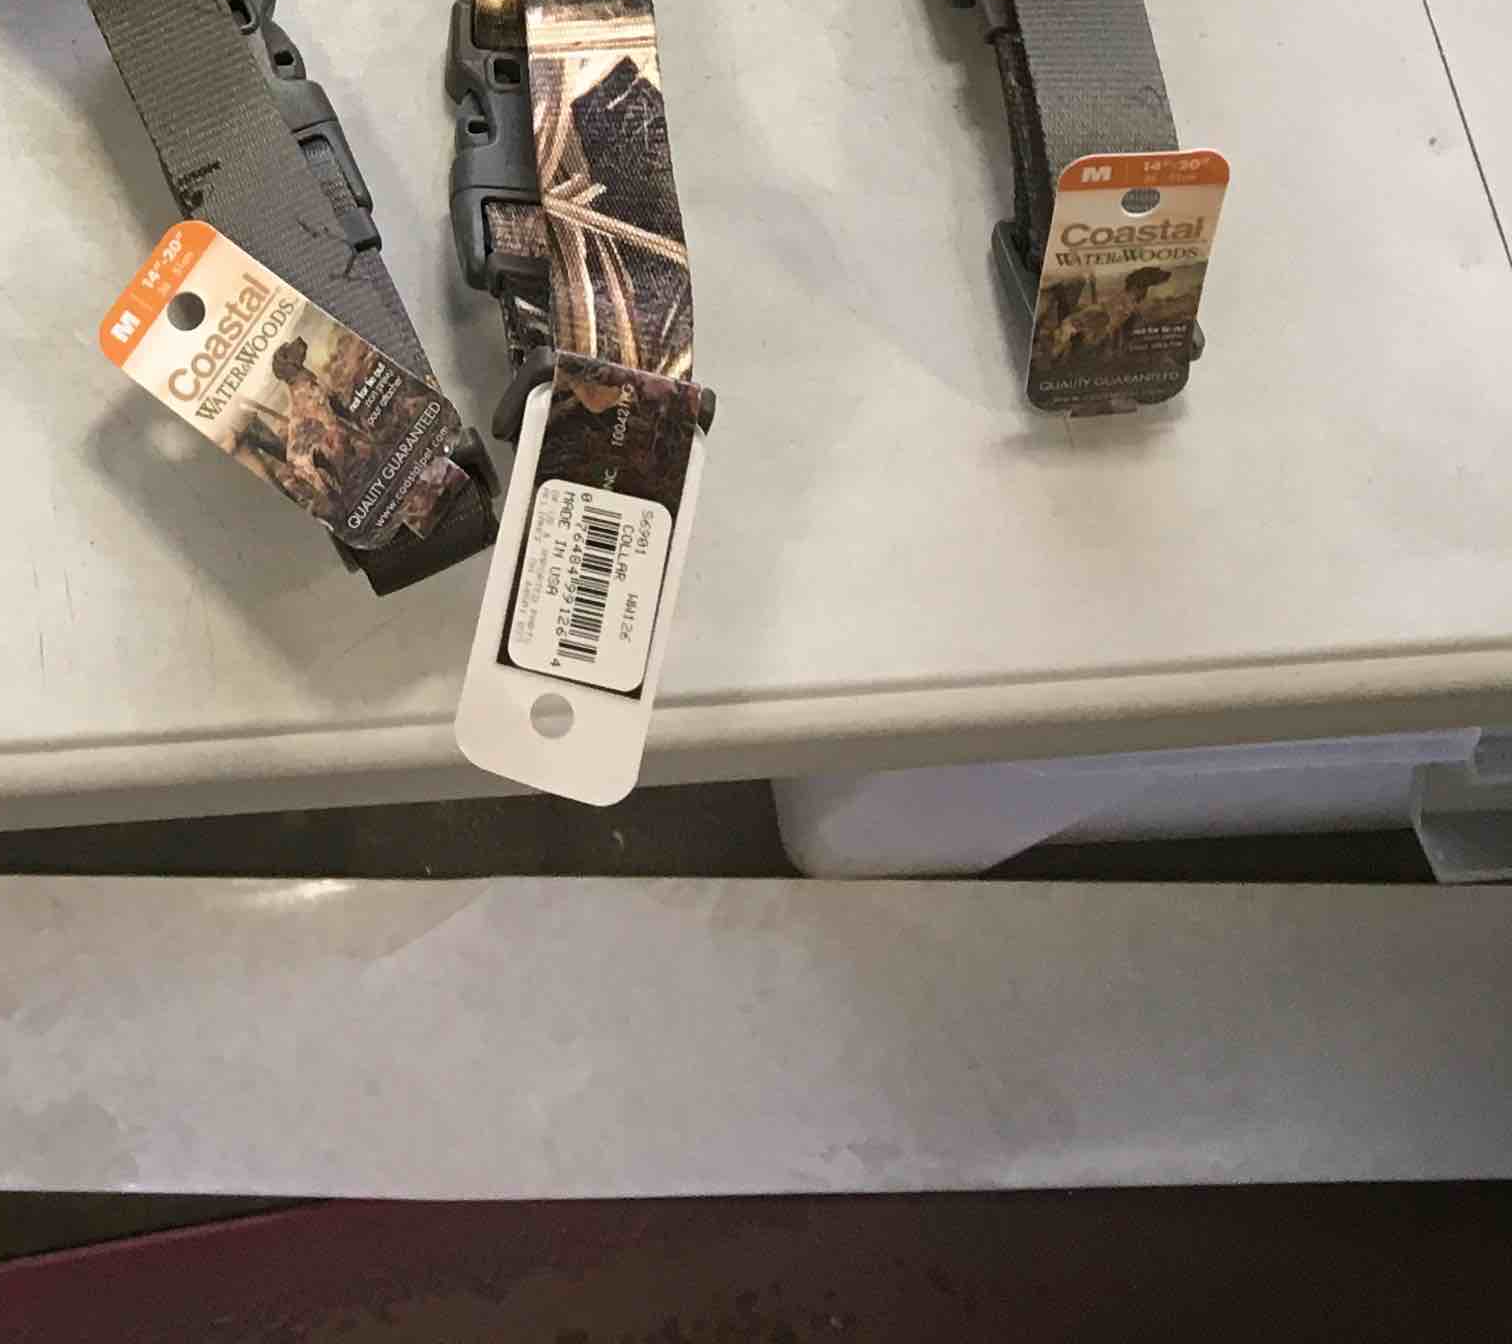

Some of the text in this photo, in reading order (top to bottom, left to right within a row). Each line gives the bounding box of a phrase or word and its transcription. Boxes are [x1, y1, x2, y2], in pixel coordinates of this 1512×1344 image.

[1081, 165, 1113, 183] M
[1060, 216, 1204, 248] Coastal
[107, 307, 143, 345] M
[160, 269, 273, 408] Coastal
[345, 398, 443, 532] QUALITY GUARANTEED
[544, 489, 576, 596] MADE IN USA
[567, 521, 587, 576] 76484
[613, 522, 635, 582] COLLAR
[554, 582, 576, 638] 99126
[618, 591, 639, 643] WW126
[548, 656, 562, 668] 4
